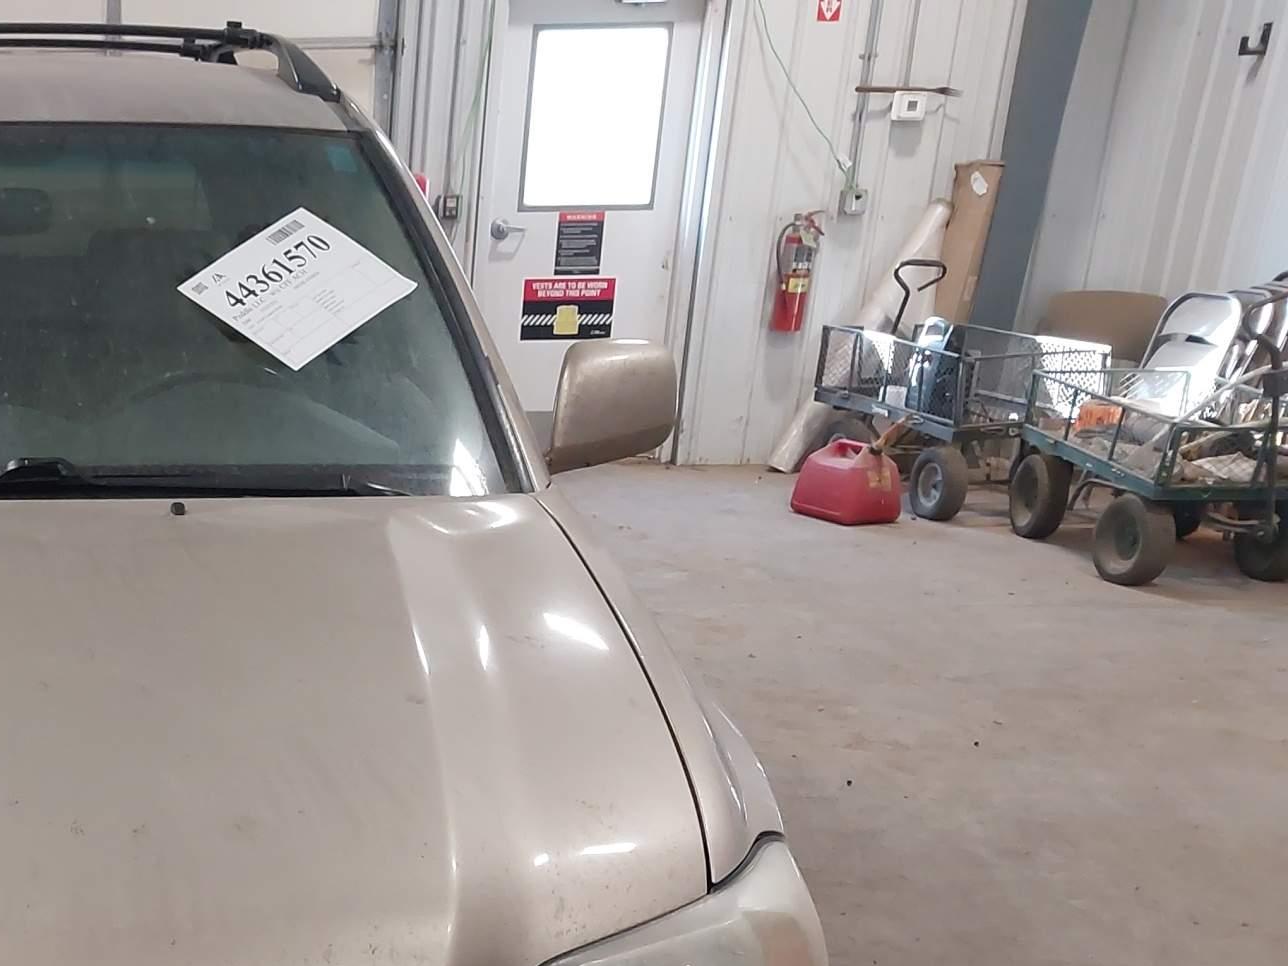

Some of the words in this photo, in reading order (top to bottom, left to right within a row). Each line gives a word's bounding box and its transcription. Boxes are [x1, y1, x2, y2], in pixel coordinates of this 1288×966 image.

[225, 235, 330, 308] 44361570
[533, 282, 552, 290] VESTS
[553, 282, 566, 290] ARE
